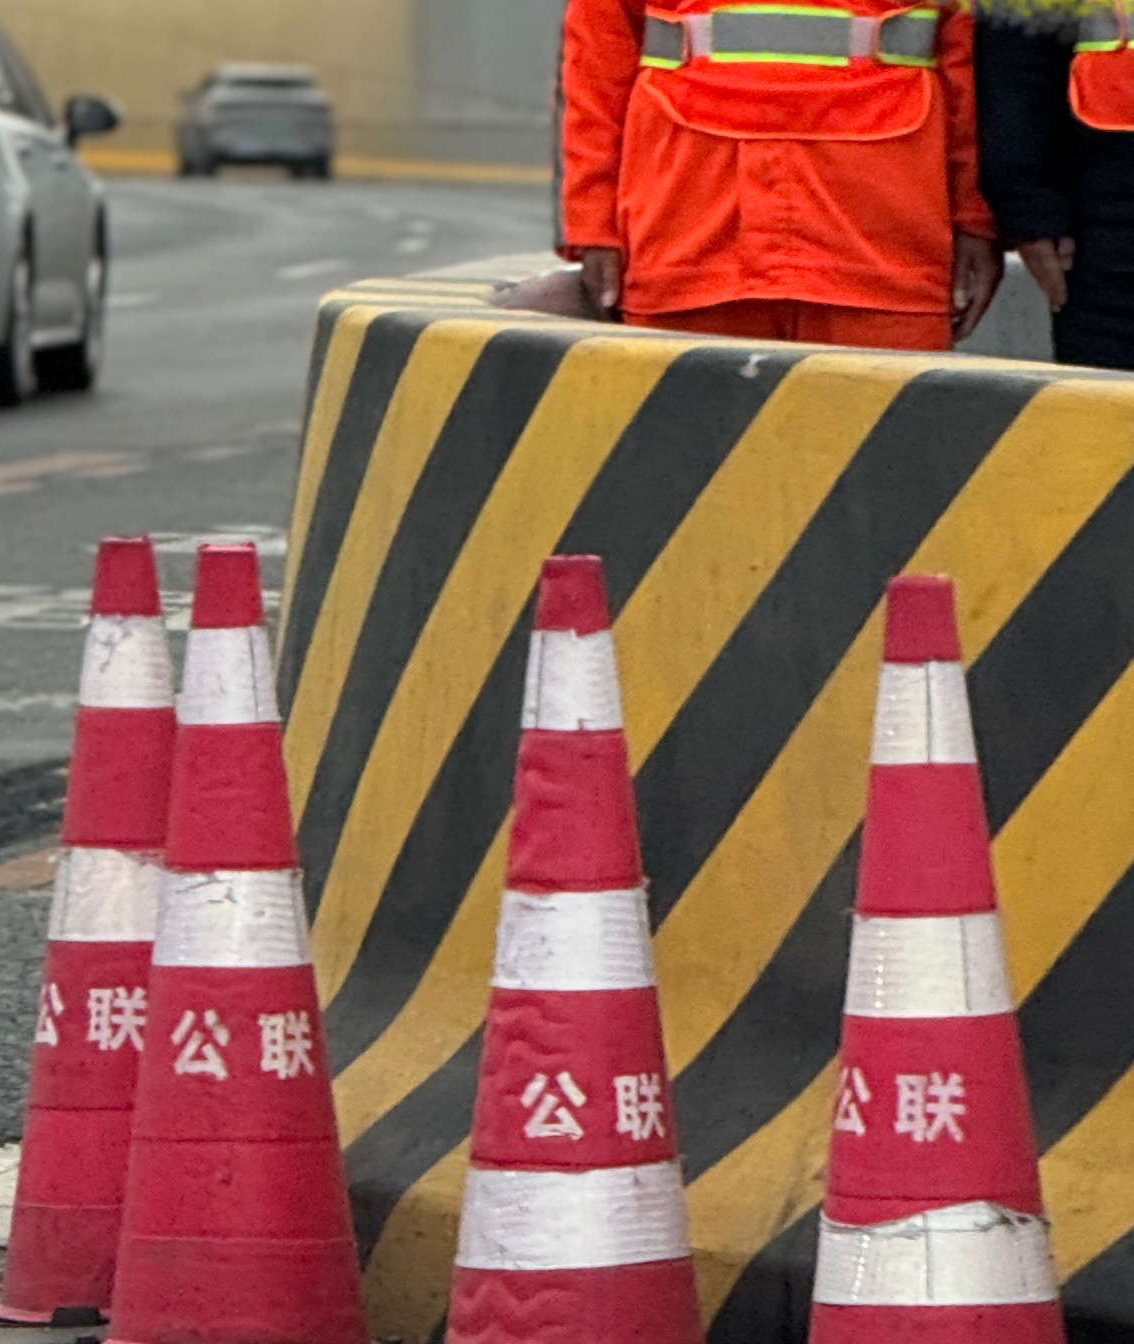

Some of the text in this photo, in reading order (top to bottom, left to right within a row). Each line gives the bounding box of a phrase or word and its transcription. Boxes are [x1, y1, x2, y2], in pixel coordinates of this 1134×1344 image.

[34, 982, 148, 1052] 公联
[170, 1008, 314, 1082] 公联
[520, 1071, 667, 1141] 公联
[834, 1066, 967, 1143] 公联
